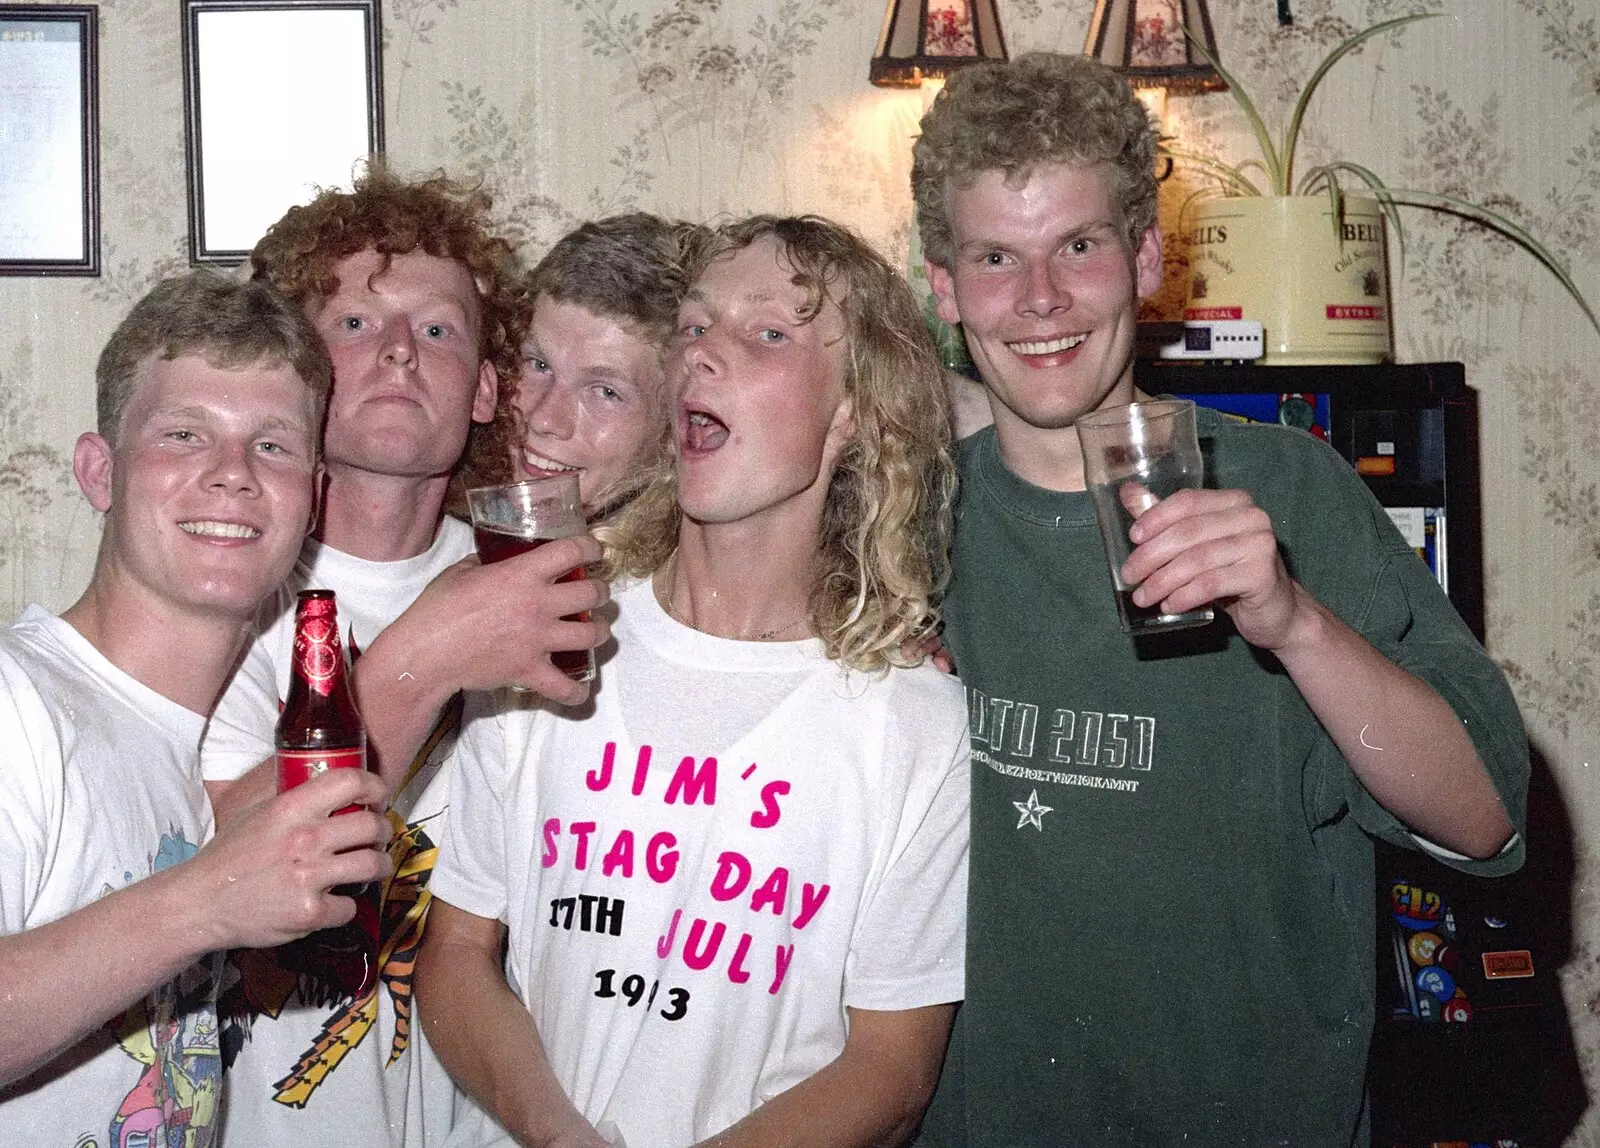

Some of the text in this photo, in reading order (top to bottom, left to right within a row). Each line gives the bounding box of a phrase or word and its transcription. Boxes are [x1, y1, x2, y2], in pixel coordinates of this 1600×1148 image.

[586, 742, 791, 828] JIM'S
[1049, 708, 1155, 771] 2050
[541, 818, 831, 930] STAG DAY
[549, 894, 795, 995] 17TH JULY
